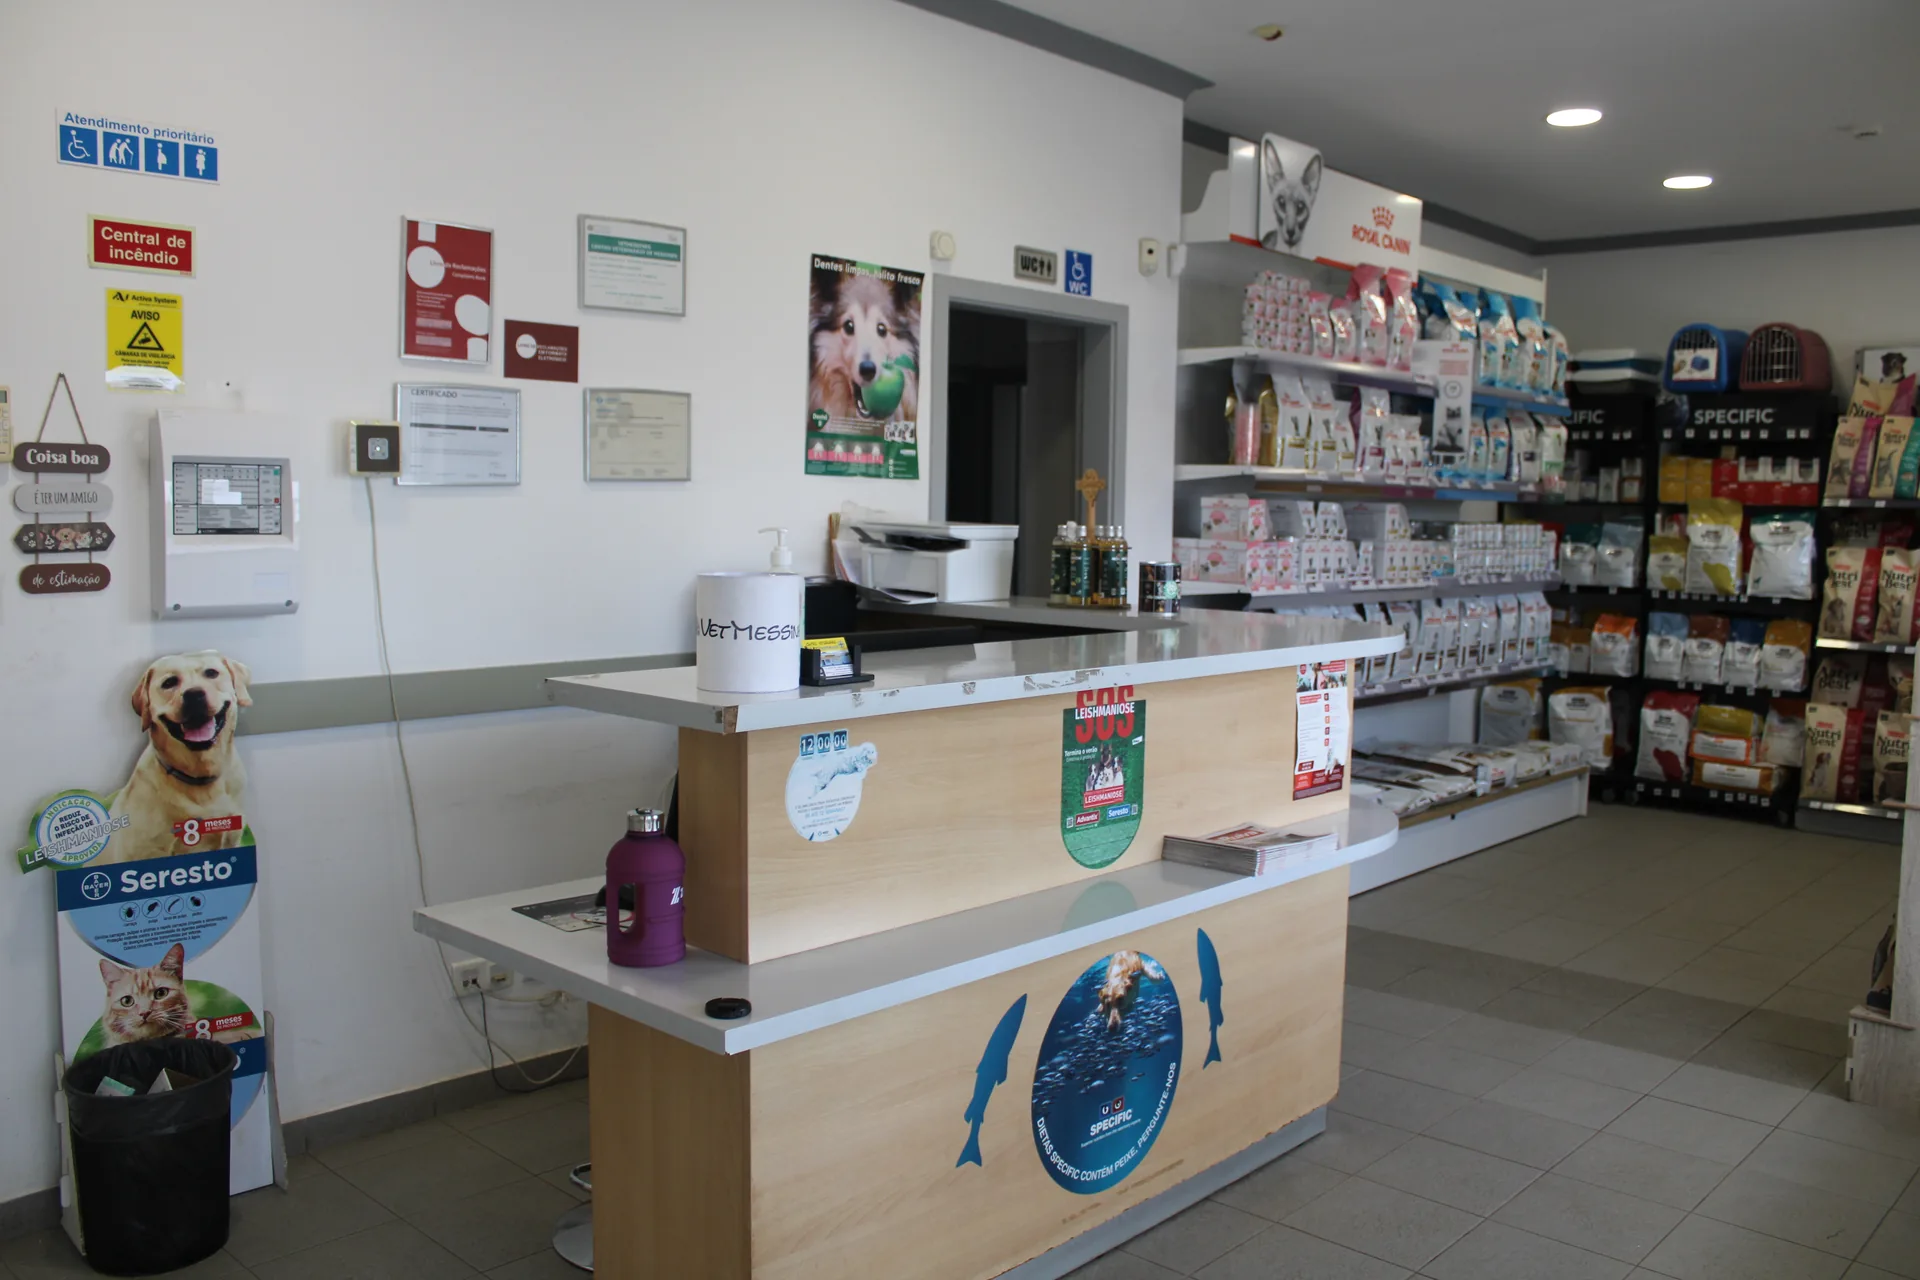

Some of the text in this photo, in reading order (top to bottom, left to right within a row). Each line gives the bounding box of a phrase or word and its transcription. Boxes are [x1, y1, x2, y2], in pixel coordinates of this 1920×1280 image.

[64, 112, 215, 145] Atendimento prioritário
[101, 227, 186, 249] Central de
[1352, 224, 1411, 256] ROYAL CANIN
[109, 245, 179, 265] incêndio
[1021, 255, 1038, 273] WC
[814, 258, 843, 272] Dentes
[897, 272, 920, 285] fresco
[1069, 281, 1088, 295] WC
[131, 310, 160, 321] AVISO
[411, 388, 458, 399] CERTIFICADO
[1694, 408, 1775, 425] SPECIFIC
[26, 448, 99, 465] Coisa boa
[35, 489, 98, 505] É TER UM AMIGO
[33, 570, 101, 588] de estimação
[1883, 570, 1916, 584] Nutri
[1885, 579, 1910, 591] Best
[1075, 702, 1135, 720] LEISHMANIOSE
[1075, 685, 1135, 744] SOS
[1808, 727, 1841, 741] Nutri
[801, 734, 847, 753] 12 00 00
[1881, 745, 1906, 757] Best
[1085, 790, 1123, 803] LEISHMANIOSE
[45, 798, 91, 820] INDICAÇÃO
[59, 811, 81, 823] REDUZ
[1108, 808, 1129, 817] Seresto
[55, 820, 94, 839] INFEÇÃO DE
[61, 819, 80, 829] RISCO
[183, 819, 232, 845] 8 meses
[25, 815, 130, 865] LEISHMANIOSE
[61, 842, 103, 862] APROVADA
[84, 882, 109, 890] BAYER
[195, 1015, 243, 1040] 8 meses
[1037, 1117, 1054, 1155] DIETAS
[1050, 1151, 1081, 1180] SPECIFIC
[1080, 1165, 1113, 1181] CONTÉM
[1114, 1147, 1138, 1171] PEIXE.
[1137, 1062, 1176, 1148] PERGUNTE-NOS
[1090, 1109, 1133, 1136] SPECIFIC
